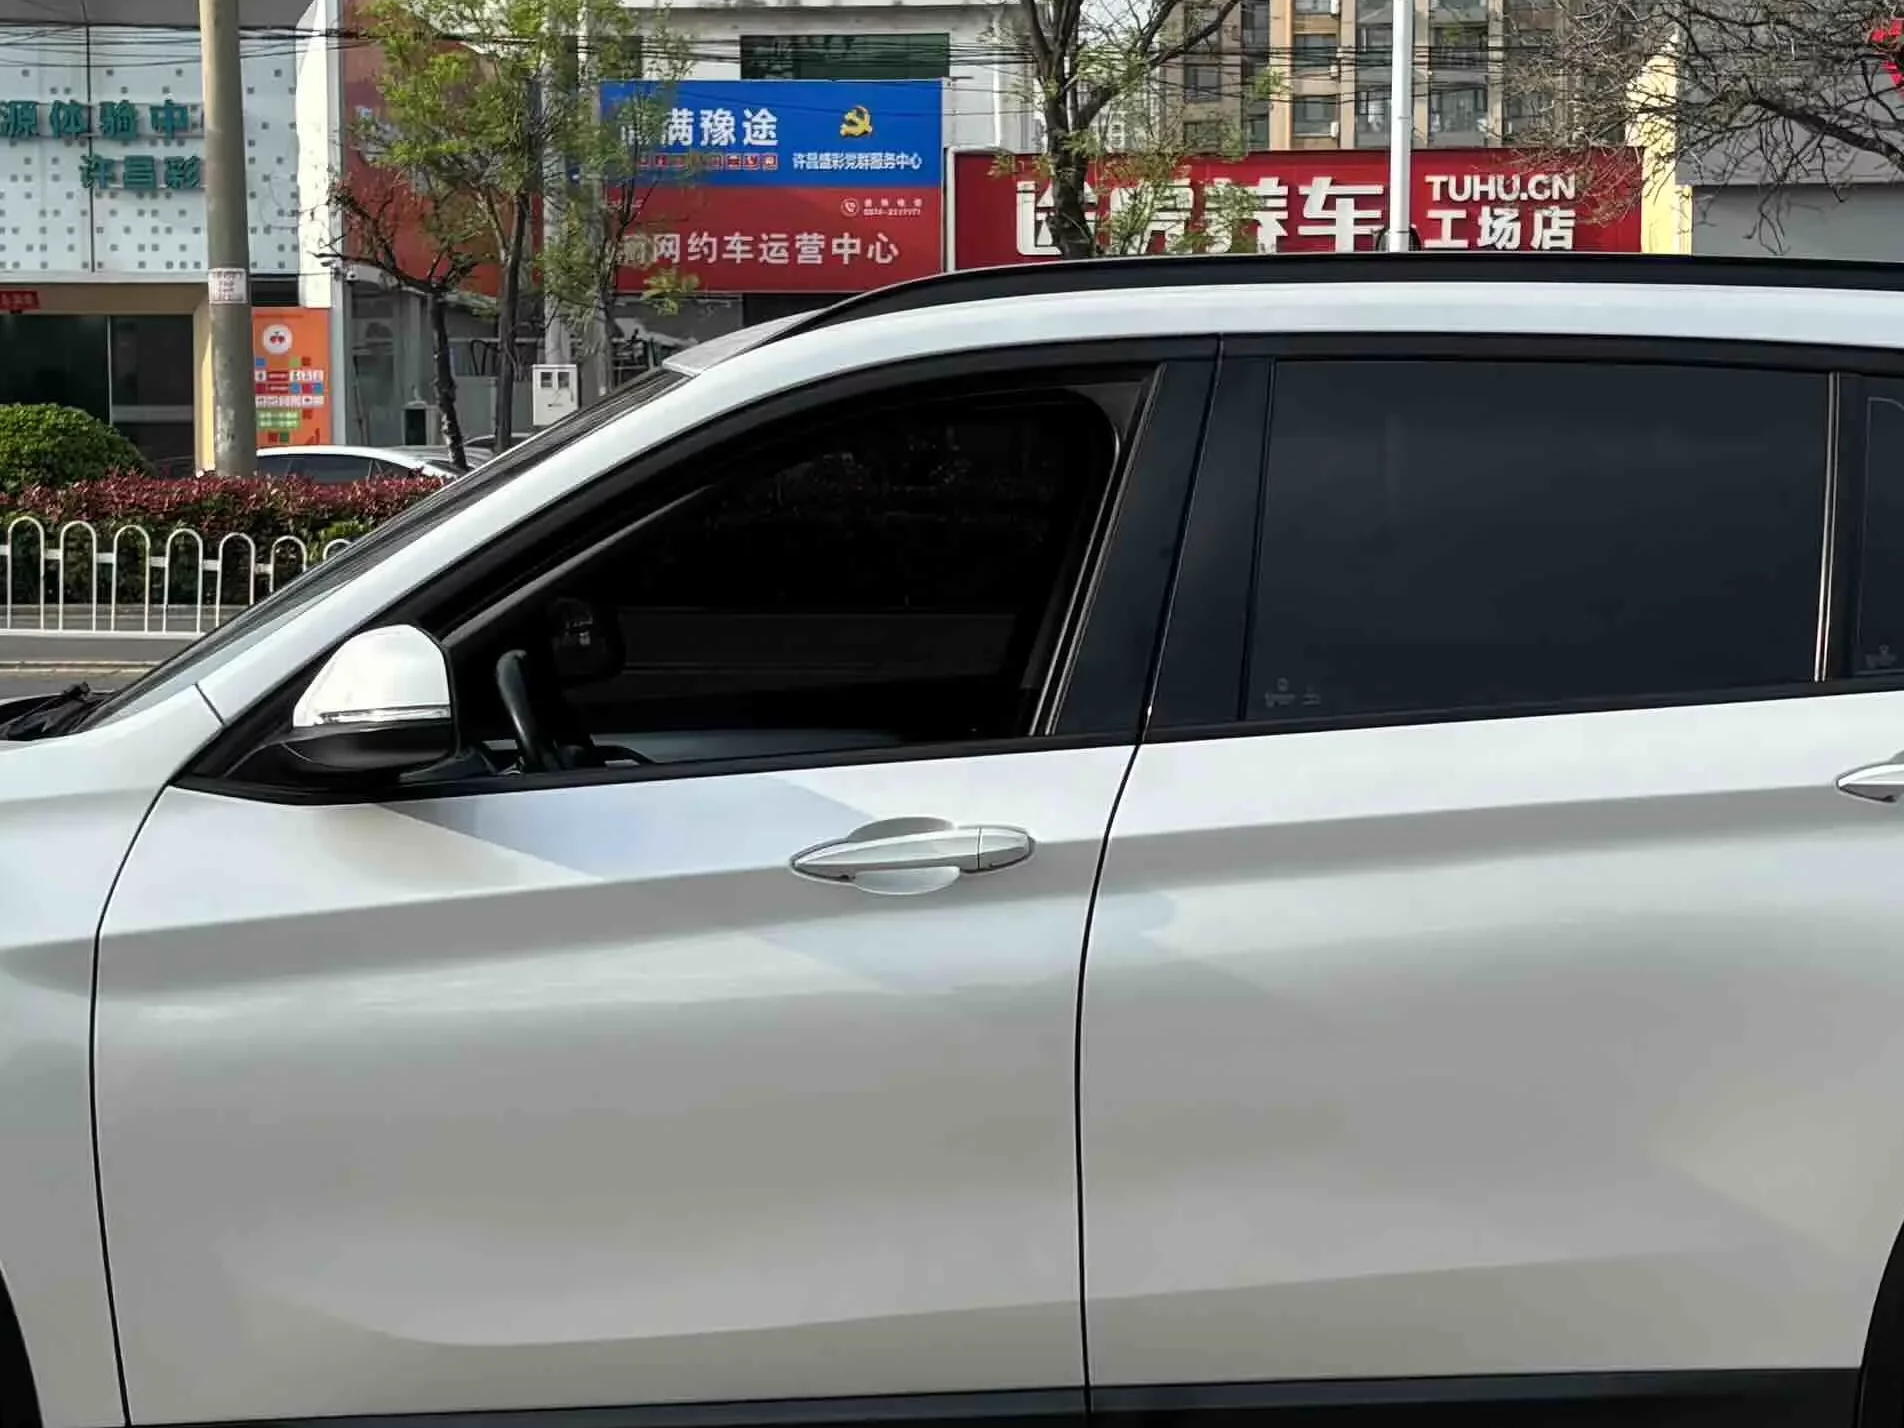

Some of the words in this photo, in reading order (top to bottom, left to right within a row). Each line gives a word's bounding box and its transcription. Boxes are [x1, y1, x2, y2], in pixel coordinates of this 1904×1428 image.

[1425, 174, 1577, 202] TUHU.CN
[1424, 206, 1576, 252] 工场店
